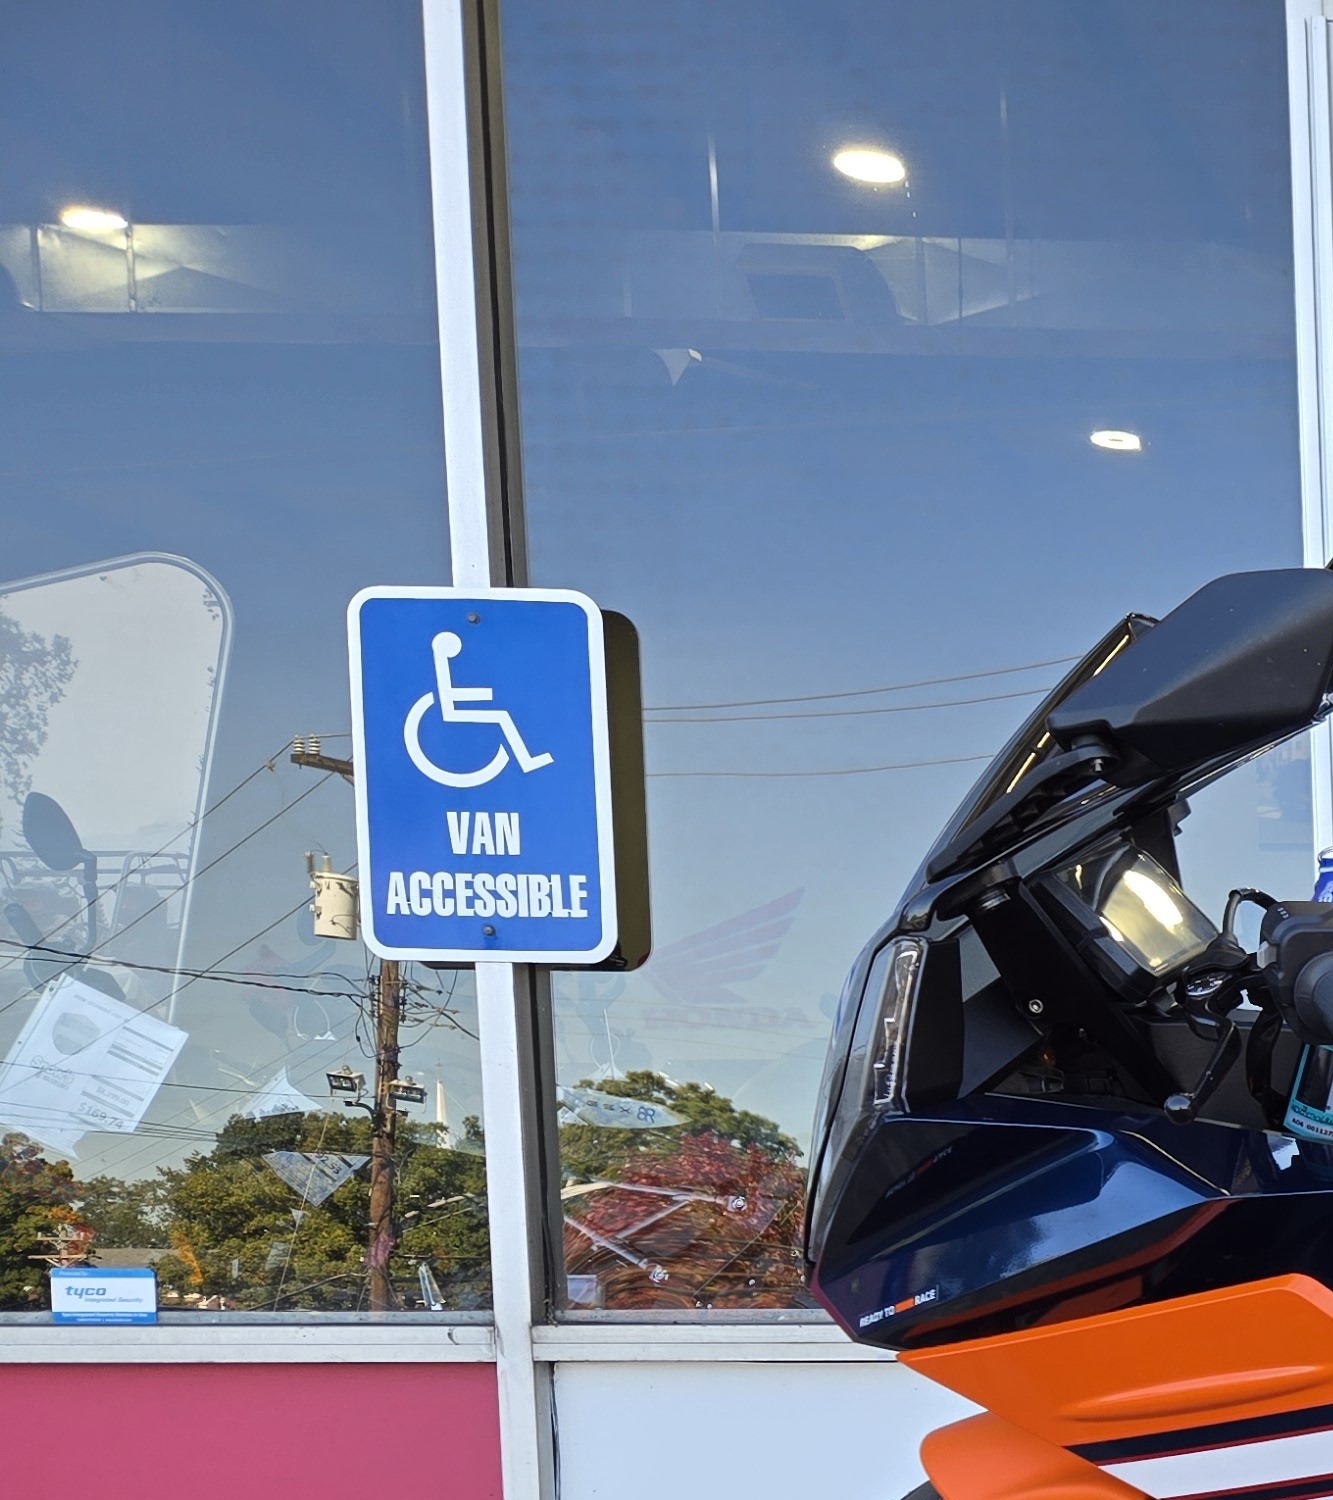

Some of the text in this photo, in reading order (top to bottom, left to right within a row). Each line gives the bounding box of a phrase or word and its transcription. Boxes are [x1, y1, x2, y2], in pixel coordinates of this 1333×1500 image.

[446, 811, 521, 856] VAN
[386, 871, 589, 919] ACCESSIBLE
[65, 1285, 107, 1299] tyco
[884, 1305, 896, 1318] TO
[914, 1289, 937, 1306] RACE
